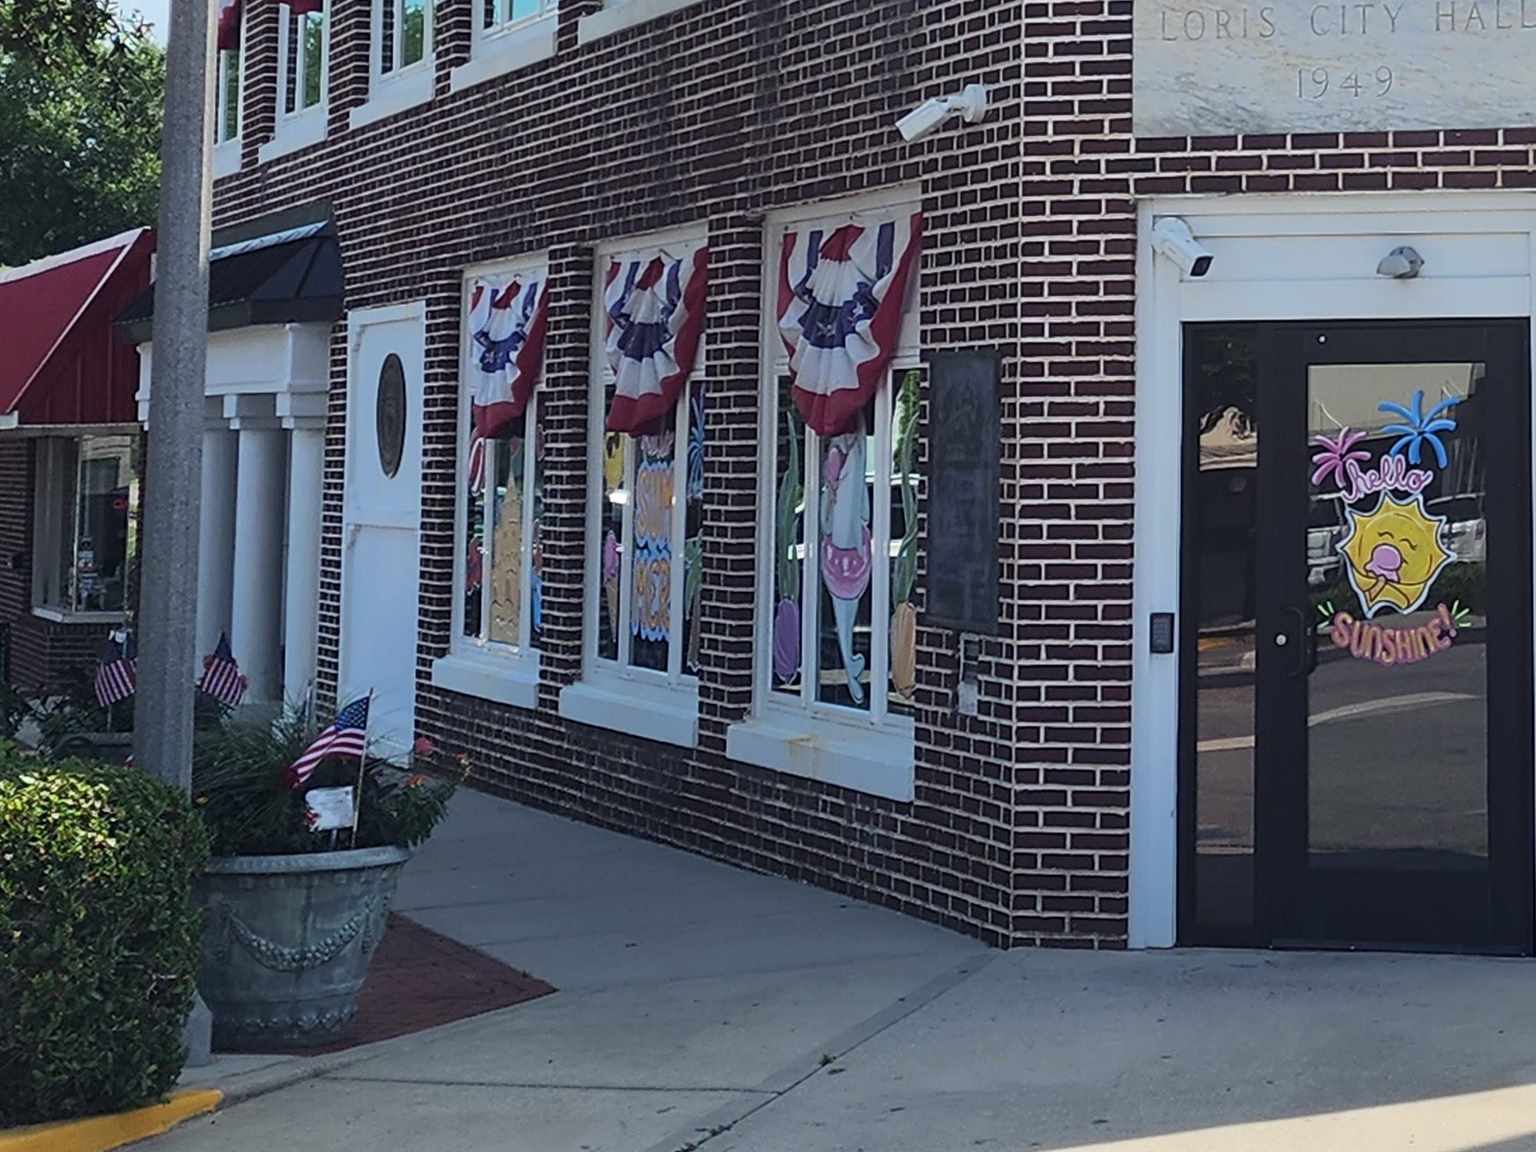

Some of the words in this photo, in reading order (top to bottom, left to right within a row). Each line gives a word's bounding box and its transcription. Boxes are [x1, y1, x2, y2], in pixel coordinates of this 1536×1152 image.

[1160, 6, 1277, 42] LORIS
[1309, 2, 1403, 37] CITY
[1296, 64, 1394, 100] 1949
[1341, 454, 1434, 503] hello
